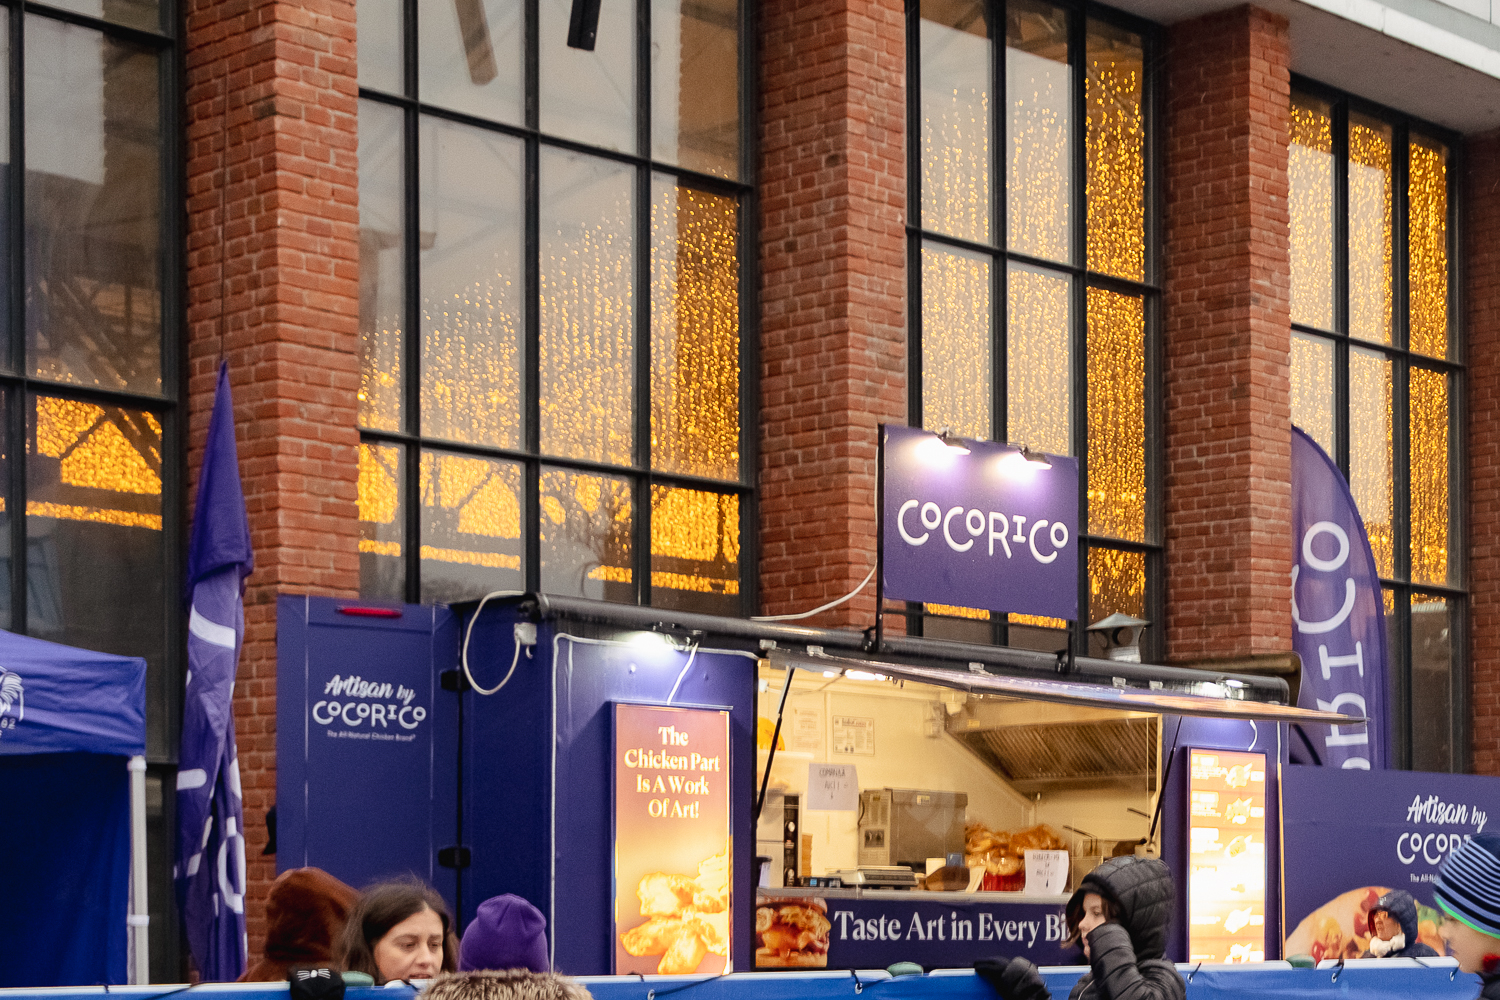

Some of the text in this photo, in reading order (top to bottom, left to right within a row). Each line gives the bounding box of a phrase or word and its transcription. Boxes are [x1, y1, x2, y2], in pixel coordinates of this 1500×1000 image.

[324, 674, 416, 706] Artisan by
[657, 725, 689, 747] The
[623, 748, 721, 773] Chicken Part
[636, 774, 710, 796] Is A Work
[648, 798, 700, 819] Of Art!
[1406, 795, 1488, 833] Artisan by
[834, 910, 1071, 949] Taste Art in Every Bi
